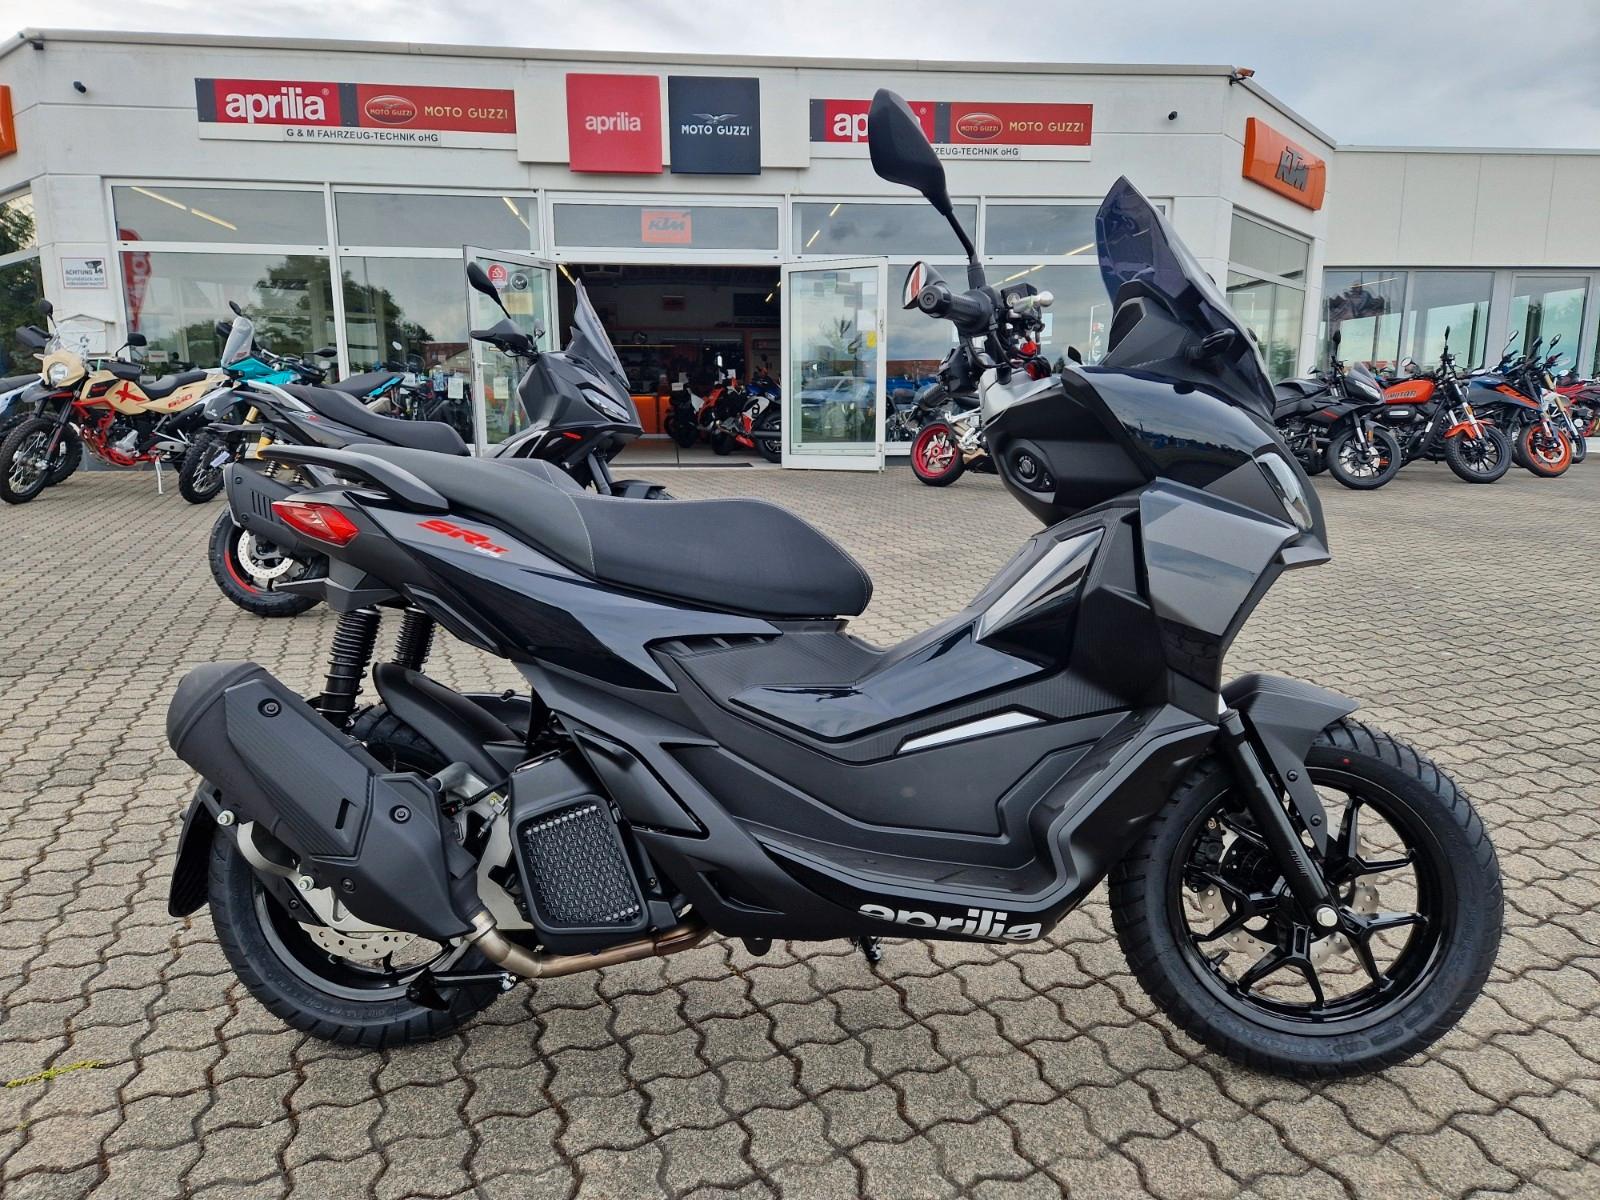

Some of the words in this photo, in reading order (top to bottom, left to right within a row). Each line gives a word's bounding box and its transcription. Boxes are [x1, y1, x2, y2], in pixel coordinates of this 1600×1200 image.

[225, 87, 325, 124] aprilia
[424, 106, 463, 117] MOTO
[467, 107, 508, 119] GUZZI
[585, 112, 641, 134] aprilia
[1009, 121, 1044, 132] MOTO
[1047, 122, 1084, 133] GUZZI
[286, 128, 294, 137] G
[297, 128, 304, 137] &
[306, 128, 315, 137] M
[317, 129, 416, 141] FAHRZEUG-TECHNIK
[418, 132, 438, 142] oHG
[681, 124, 713, 135] MOTO
[716, 125, 751, 136] GUZZI
[935, 147, 999, 156] ZEUG-TECHNIK
[1001, 148, 1019, 156] oHG
[65, 268, 93, 276] ACHTUNG
[858, 904, 1042, 941] aprilia
